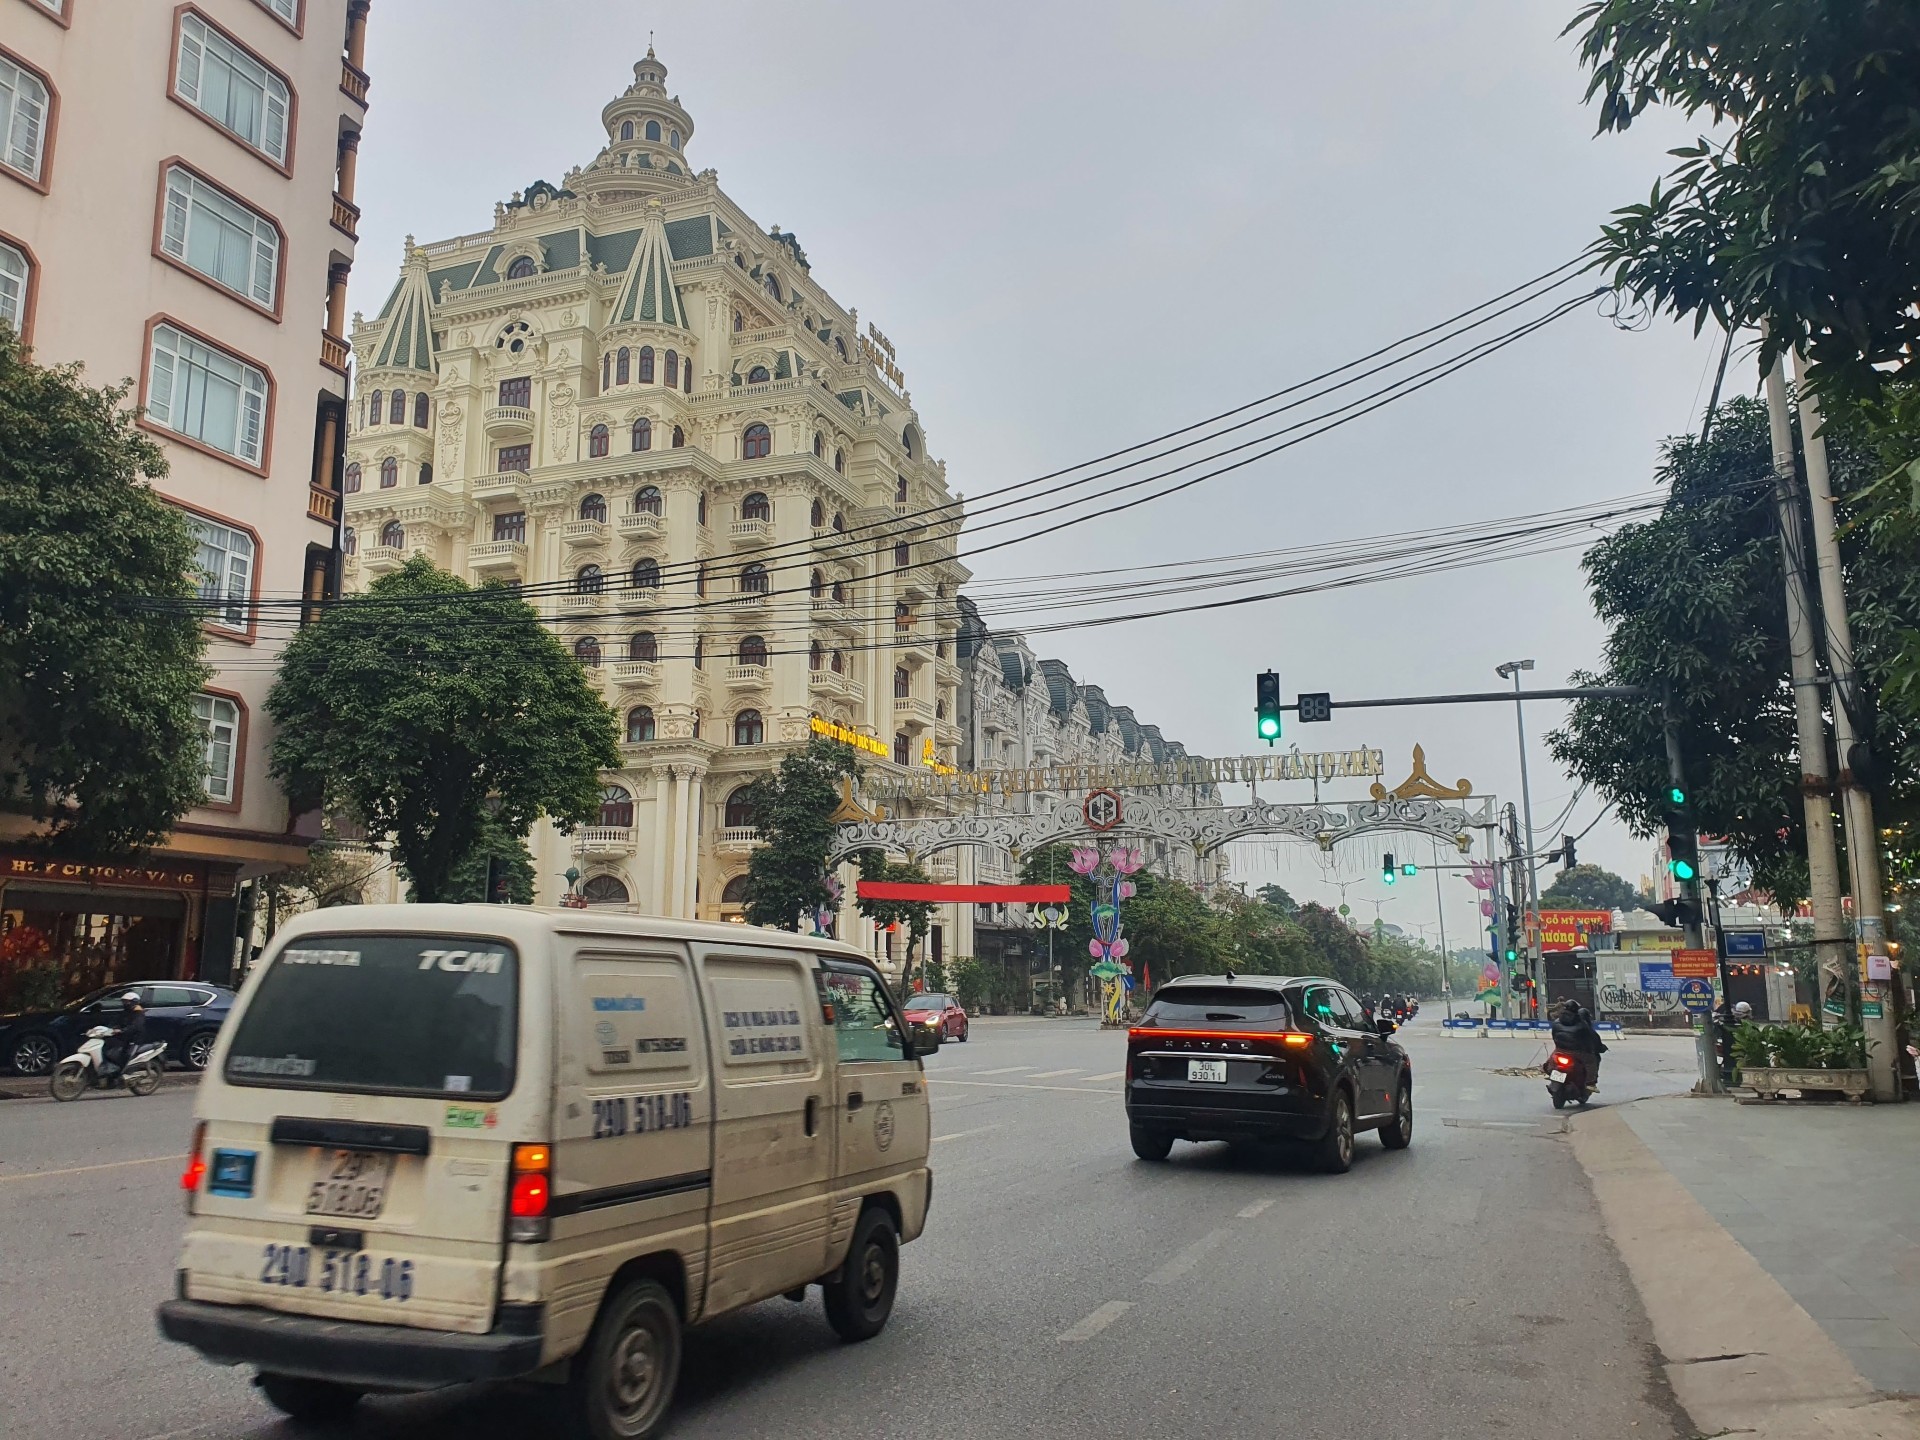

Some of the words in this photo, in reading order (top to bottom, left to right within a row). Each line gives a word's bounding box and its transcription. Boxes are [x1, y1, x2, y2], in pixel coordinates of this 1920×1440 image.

[418, 950, 504, 974] TCM
[1199, 1062, 1216, 1072] 30L
[1191, 1071, 1222, 1081] 930.11
